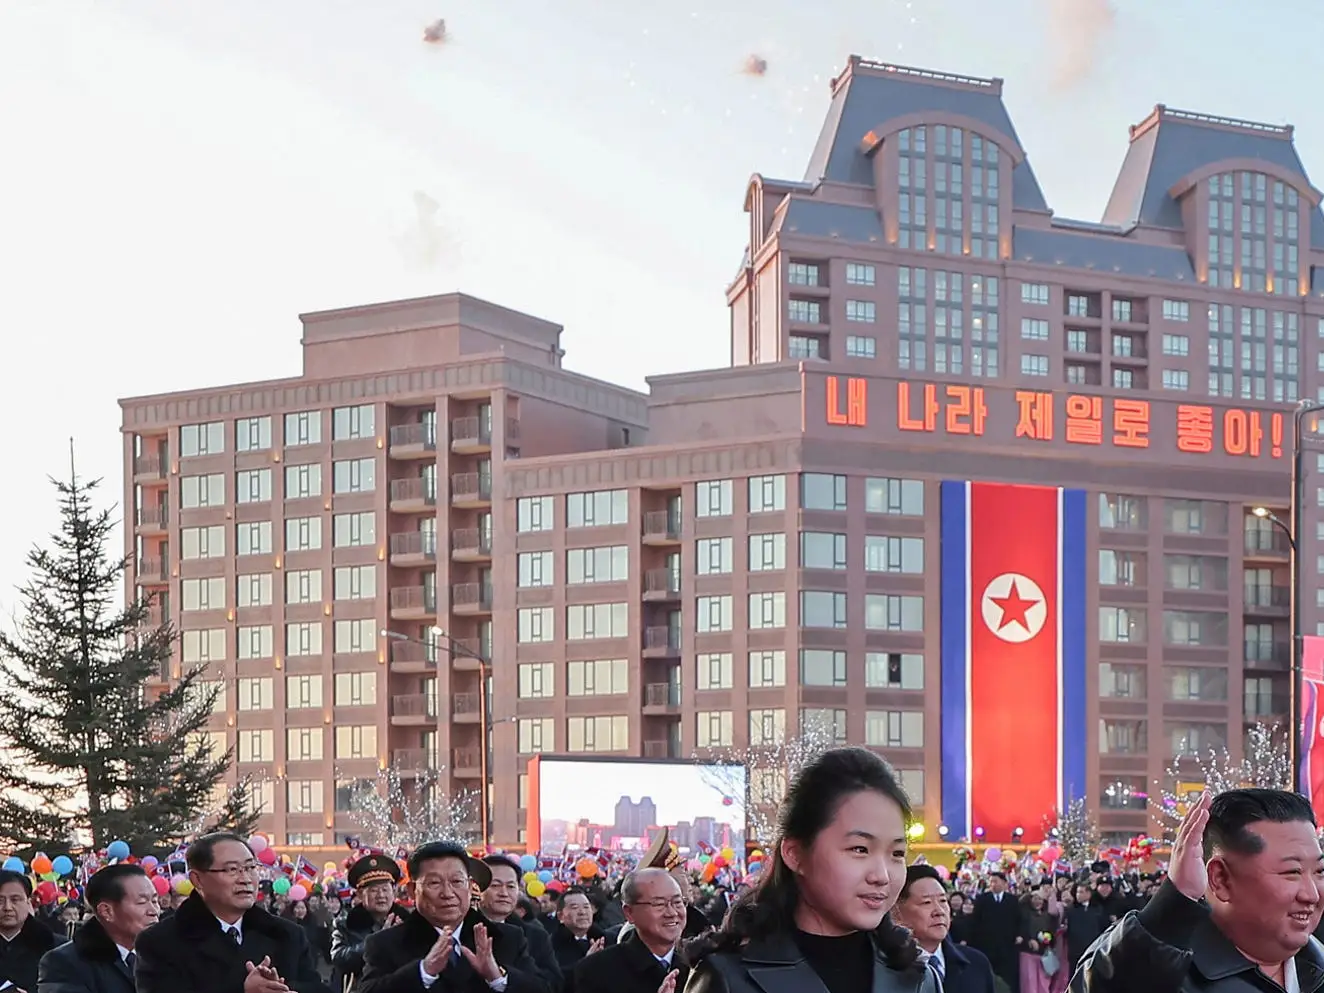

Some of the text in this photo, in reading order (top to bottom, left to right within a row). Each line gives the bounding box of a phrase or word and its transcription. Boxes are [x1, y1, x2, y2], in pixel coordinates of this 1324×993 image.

[826, 376, 1283, 458] 내 나라 제일로 좋아!
